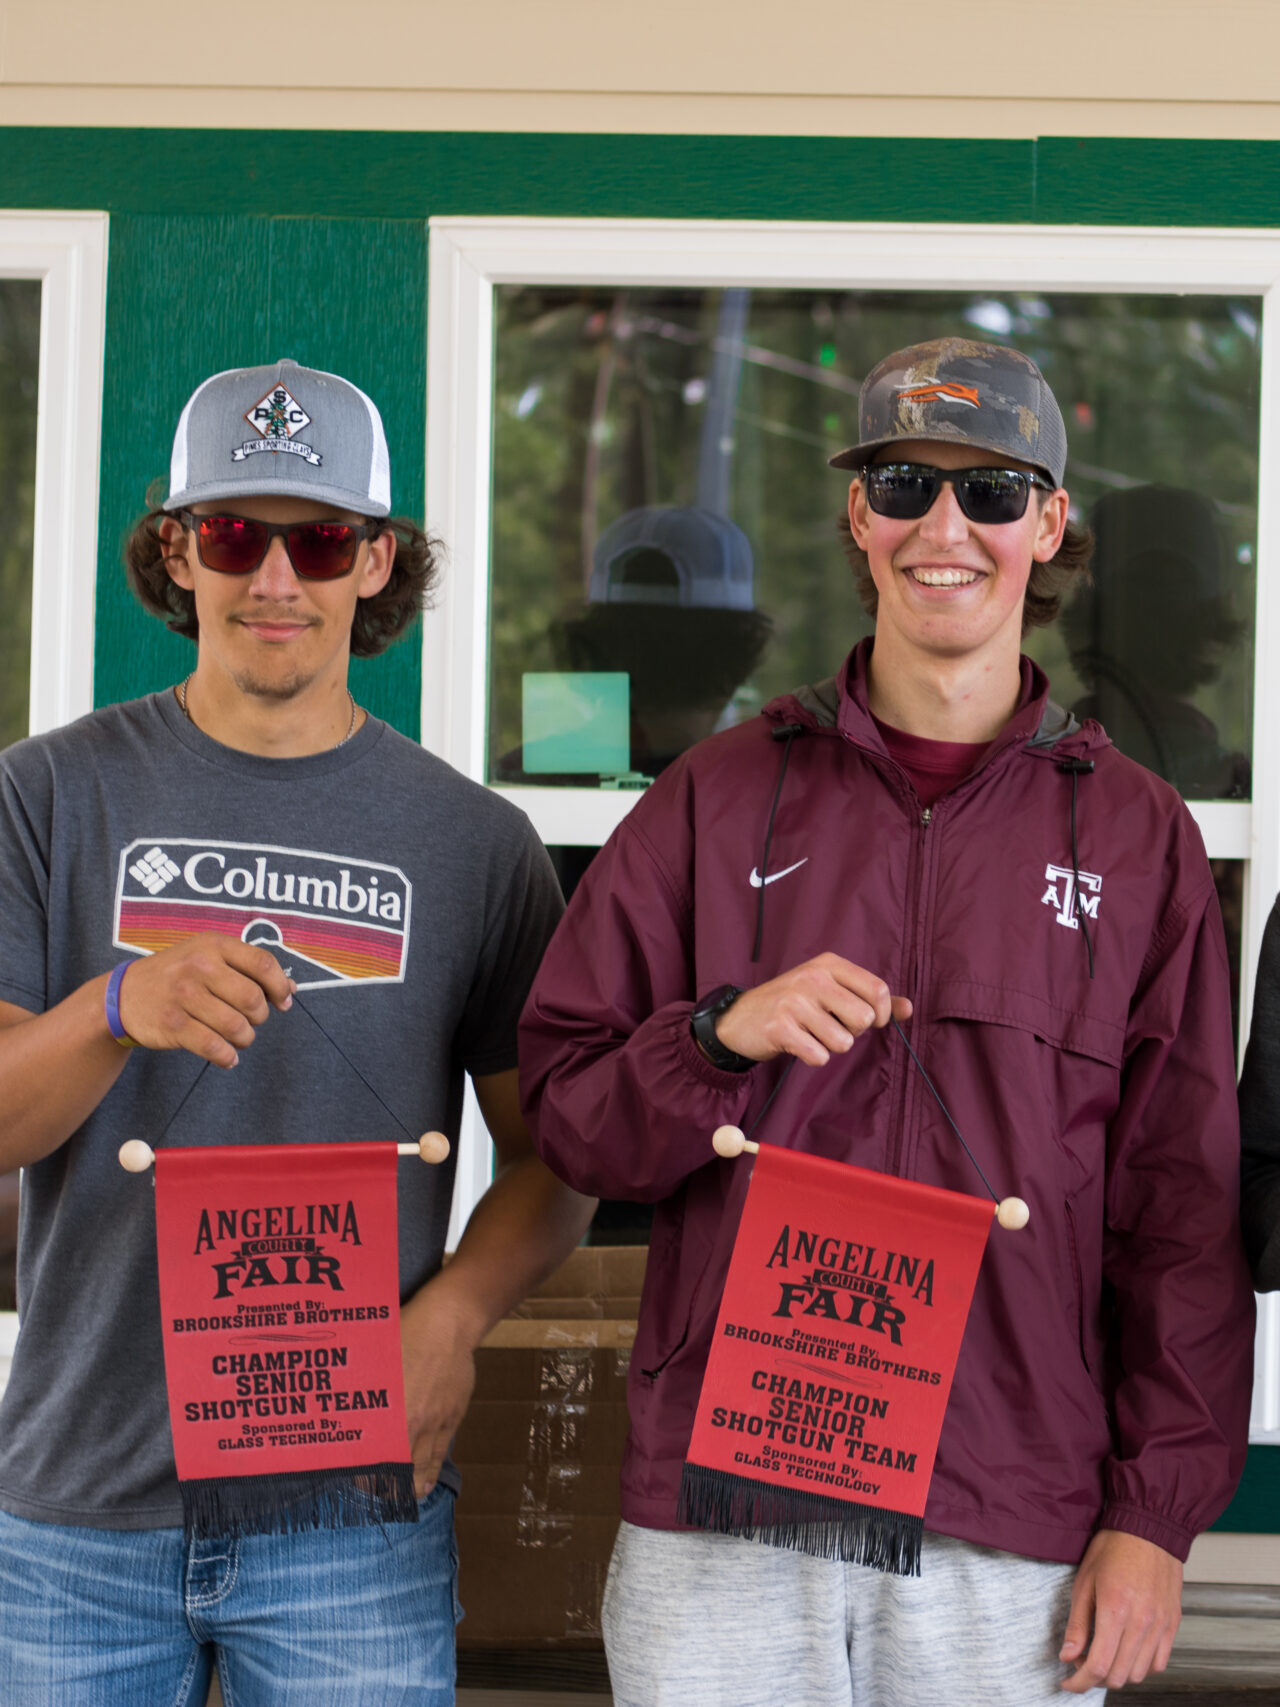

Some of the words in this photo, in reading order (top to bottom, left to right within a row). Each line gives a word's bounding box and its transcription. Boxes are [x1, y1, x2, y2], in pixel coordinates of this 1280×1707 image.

[273, 391, 286, 403] S
[254, 408, 269, 420] P
[290, 410, 303, 423] C
[183, 851, 401, 921] Columbia
[194, 1201, 361, 1254] ANGELINA
[247, 1239, 308, 1253] COUNTY
[211, 1256, 344, 1299] FAIR
[766, 1224, 935, 1307] ANGELINA
[819, 1271, 880, 1294] COUNTY
[173, 1311, 289, 1332] BROOKSHIRE
[293, 1306, 390, 1324] BROTHERS
[237, 1301, 300, 1313] Presented
[305, 1300, 325, 1312] By:
[771, 1282, 906, 1346] FAIR
[724, 1323, 838, 1361] BROOKSHIRE
[844, 1352, 941, 1385] BROTHERS
[792, 1328, 856, 1351] Presented
[858, 1343, 879, 1359] By:
[212, 1347, 348, 1375] CHAMPION
[236, 1370, 331, 1396] SENIOR
[751, 1371, 889, 1419] CHAMPION
[185, 1395, 307, 1421] SHOTGUN
[315, 1389, 389, 1412] TEAM
[768, 1399, 866, 1438] SENIOR
[218, 1435, 264, 1450] GLASS
[268, 1430, 362, 1447] TECHNOLOGY
[242, 1421, 316, 1437] Sponsored
[320, 1419, 341, 1433] By:
[711, 1407, 834, 1452] SHOTGUN
[844, 1439, 917, 1472] TEAM
[734, 1451, 780, 1473] GLASS
[785, 1463, 880, 1495] TECHNOLOGY
[762, 1445, 836, 1471] Sponsored
[840, 1463, 862, 1478] By:
